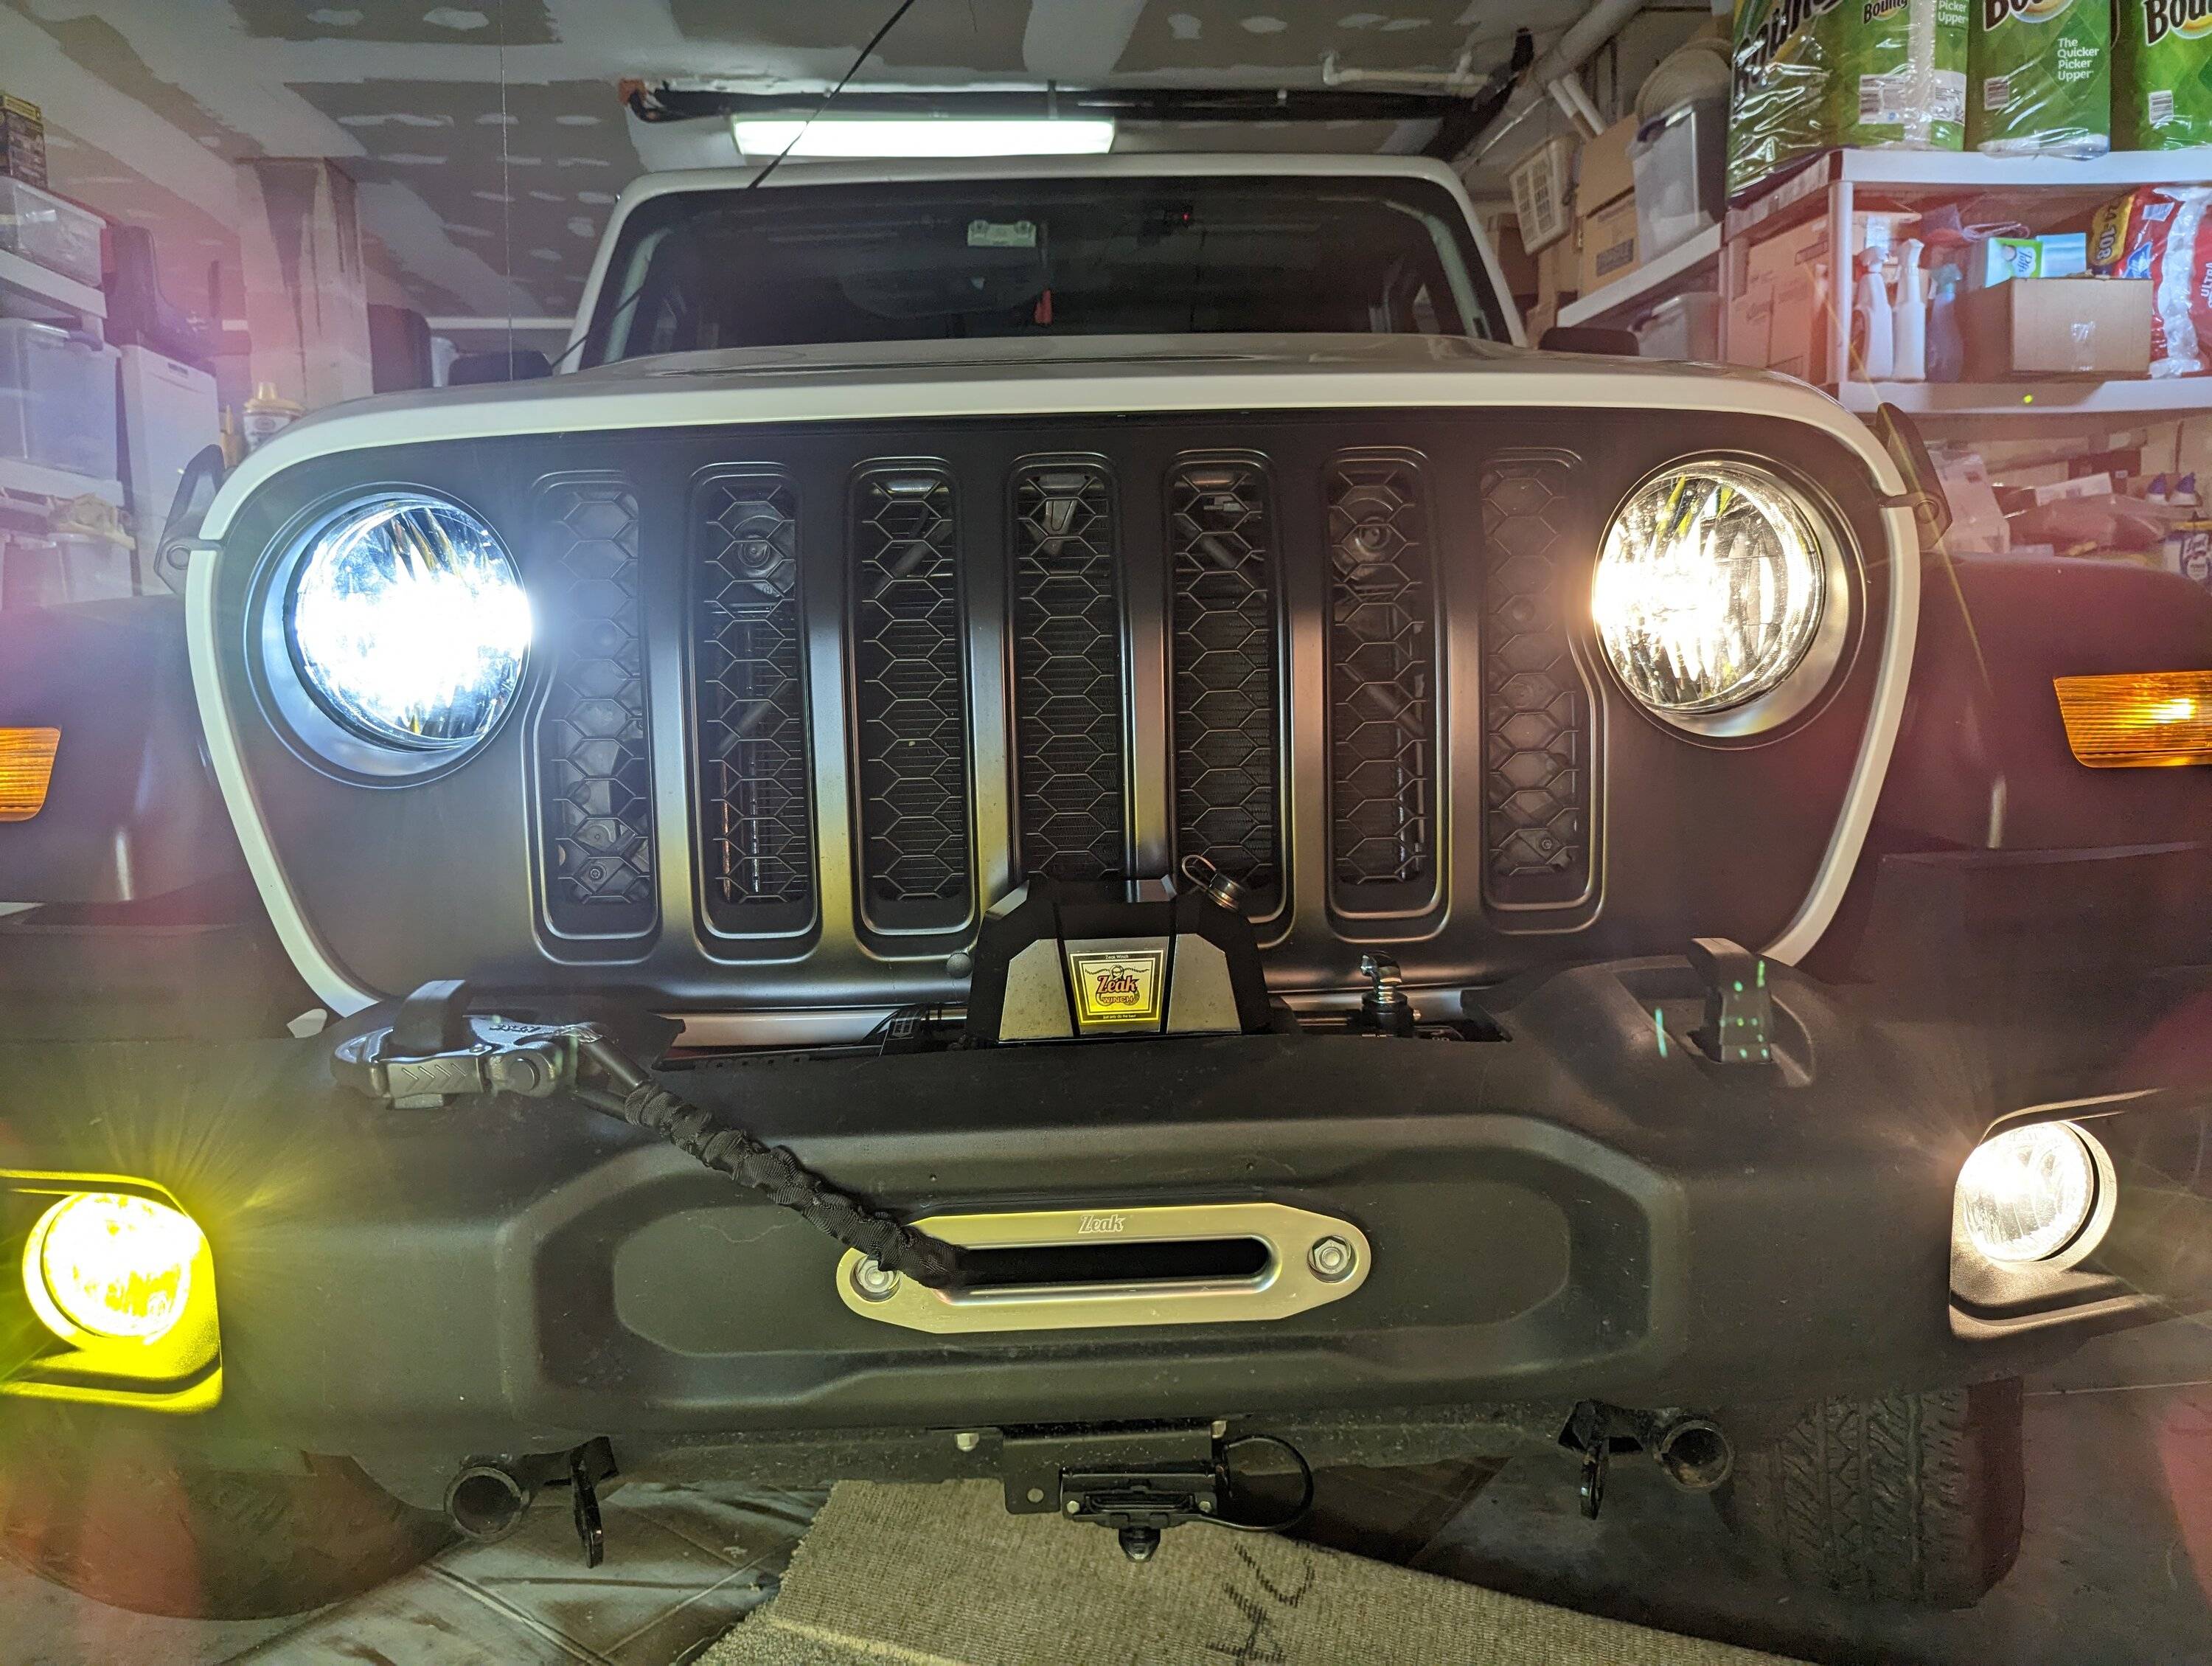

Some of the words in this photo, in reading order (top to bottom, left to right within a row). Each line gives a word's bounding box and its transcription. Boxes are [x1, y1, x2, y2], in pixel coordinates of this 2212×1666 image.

[2058, 38, 2078, 47] The
[2057, 46, 2100, 59] Quicker
[2058, 59, 2093, 69] Picker
[2058, 71, 2091, 82] Upper
[1096, 975, 1140, 993] Zeak
[1102, 996, 1134, 1004] WINCH
[1078, 1214, 1127, 1234] Zeak
